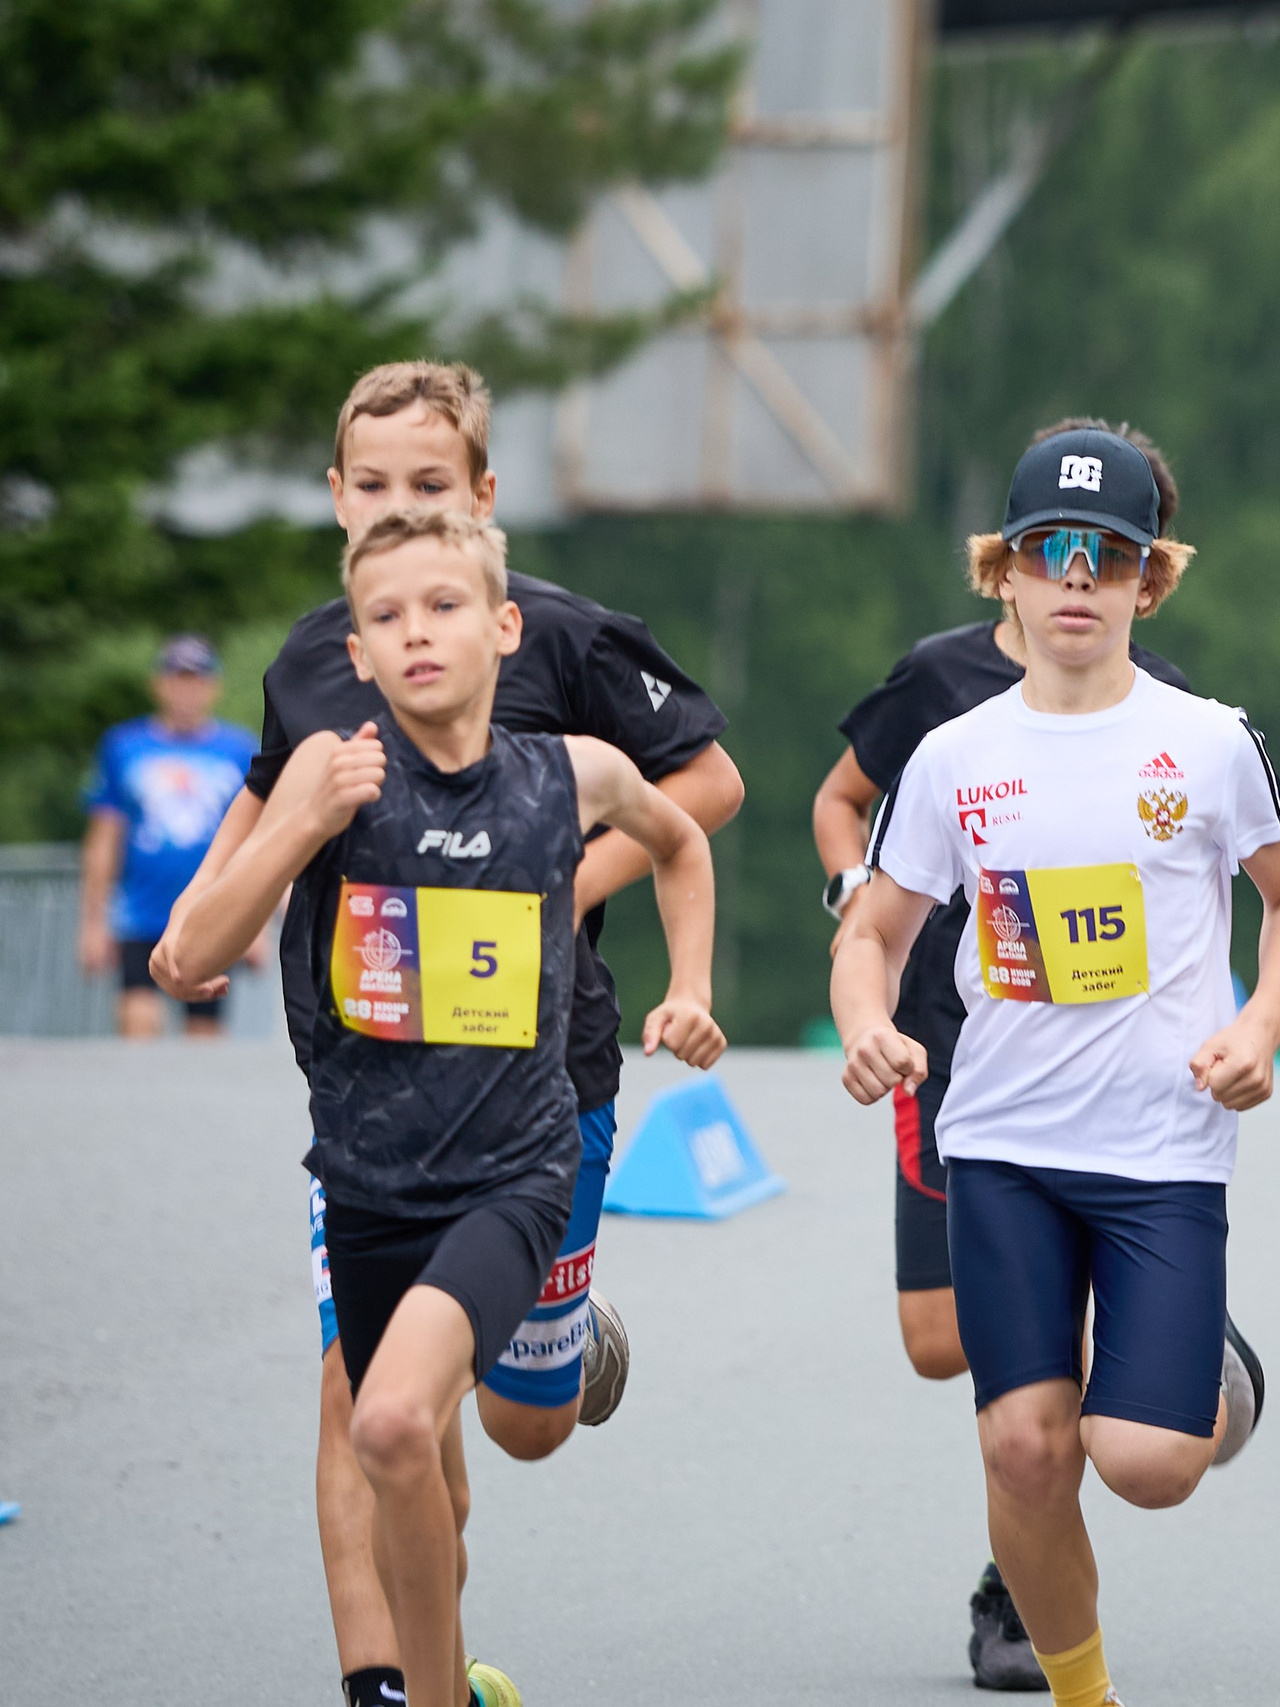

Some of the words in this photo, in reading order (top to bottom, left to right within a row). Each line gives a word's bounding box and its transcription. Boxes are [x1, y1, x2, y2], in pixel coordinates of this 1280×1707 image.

[1138, 769, 1184, 779] adidas
[957, 779, 1028, 806] LUKOIL
[992, 811, 1023, 826] RUSAL
[417, 830, 492, 858] FILA
[1060, 905, 1126, 944] 115
[469, 941, 498, 979] 5
[1072, 965, 1124, 981] Детский
[1082, 981, 1116, 993] забег
[452, 1006, 509, 1018] Детский
[461, 1023, 498, 1034] забег
